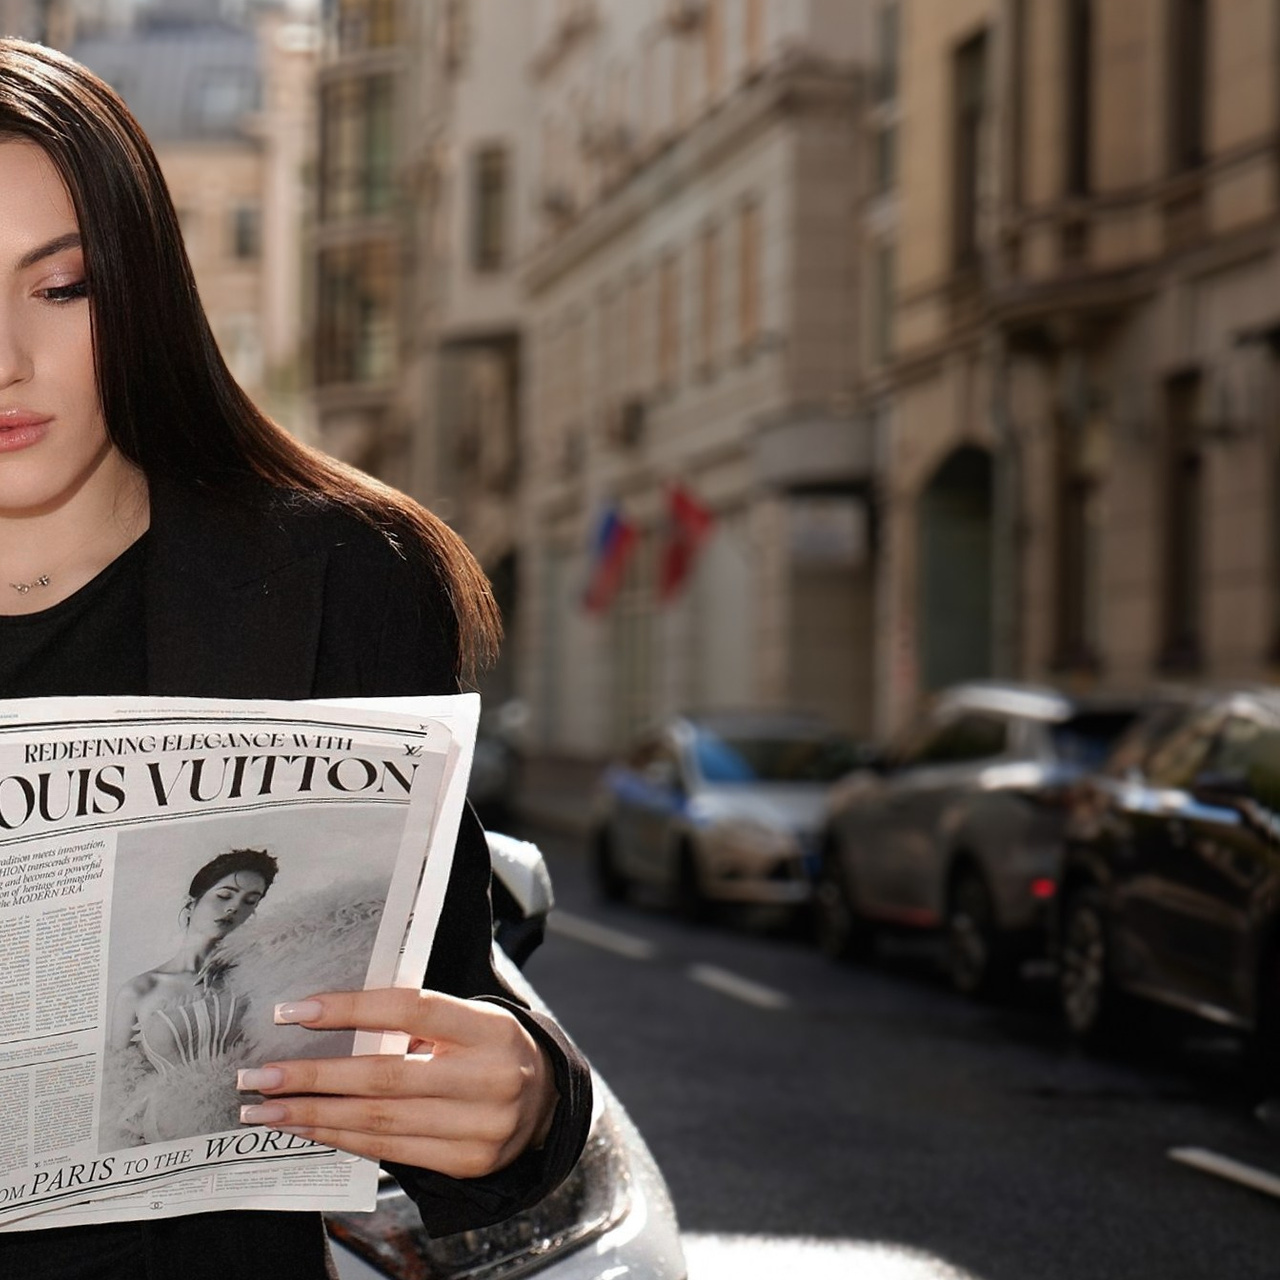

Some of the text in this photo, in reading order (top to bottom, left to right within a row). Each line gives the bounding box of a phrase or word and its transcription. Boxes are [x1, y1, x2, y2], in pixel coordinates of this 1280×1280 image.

[24, 732, 353, 764] REDEFINING ELEGANCE WITH
[146, 755, 419, 807] VUITTON
[27, 856, 70, 872] transcends
[72, 852, 93, 863] mere
[32, 849, 56, 860] meets
[57, 840, 106, 856] innovation,
[5, 875, 21, 887] and
[22, 870, 56, 883] becomes
[64, 859, 102, 876] powerful
[11, 886, 21, 897] of
[23, 880, 55, 892] heritage
[56, 869, 104, 887] reimagined
[12, 890, 58, 907] MODERN
[61, 884, 84, 896] ERA.
[29, 1157, 116, 1197] PARIS
[123, 1157, 149, 1176] TO
[153, 1149, 194, 1170] THE
[205, 1130, 325, 1160] WORL
